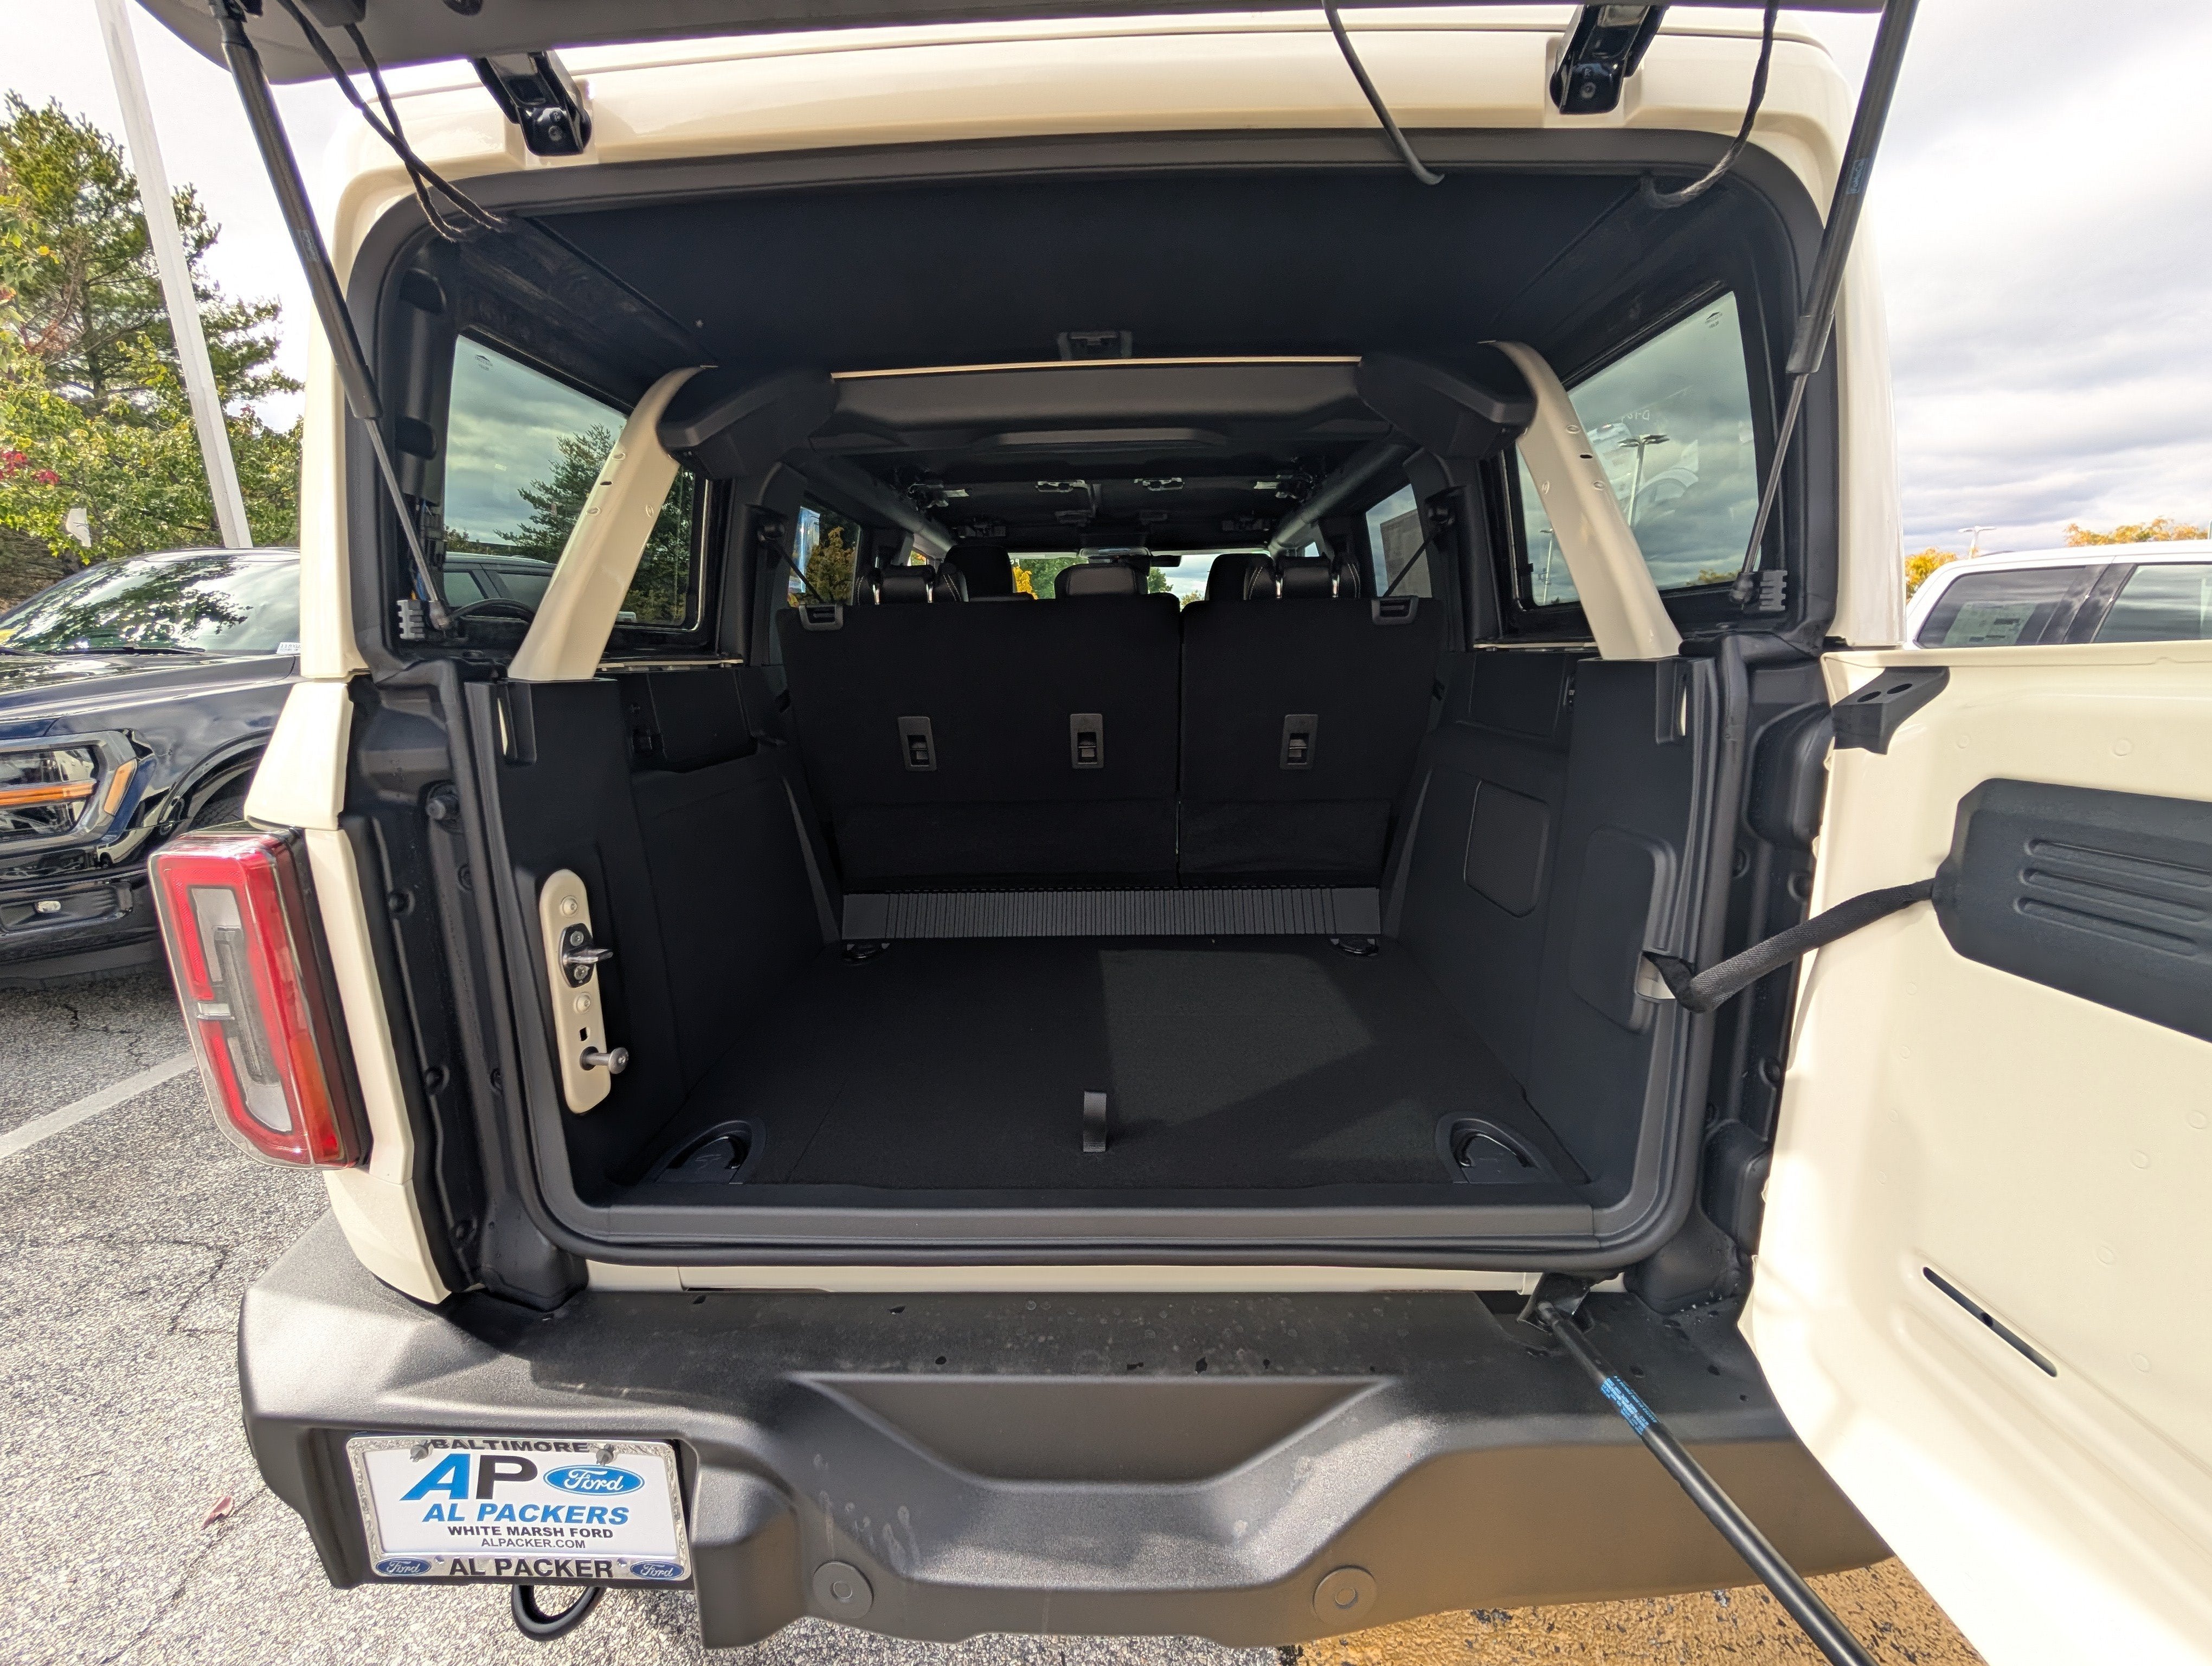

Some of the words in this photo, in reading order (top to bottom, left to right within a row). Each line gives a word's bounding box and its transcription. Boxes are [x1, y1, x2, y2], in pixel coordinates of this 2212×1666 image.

[431, 1439, 590, 1453] BALTIMORE
[400, 1453, 537, 1501] AP
[563, 1467, 623, 1491] Ford
[422, 1503, 466, 1523] AL
[477, 1503, 629, 1524] PACKERS
[447, 1526, 502, 1536] WHITE
[507, 1527, 564, 1537] MARSH
[570, 1528, 613, 1538] FORD
[481, 1538, 586, 1548] ALPACKER.COM
[386, 1560, 421, 1574] Ford
[449, 1558, 486, 1575] AL
[496, 1558, 613, 1578] PACKER
[640, 1563, 673, 1577] Ford
